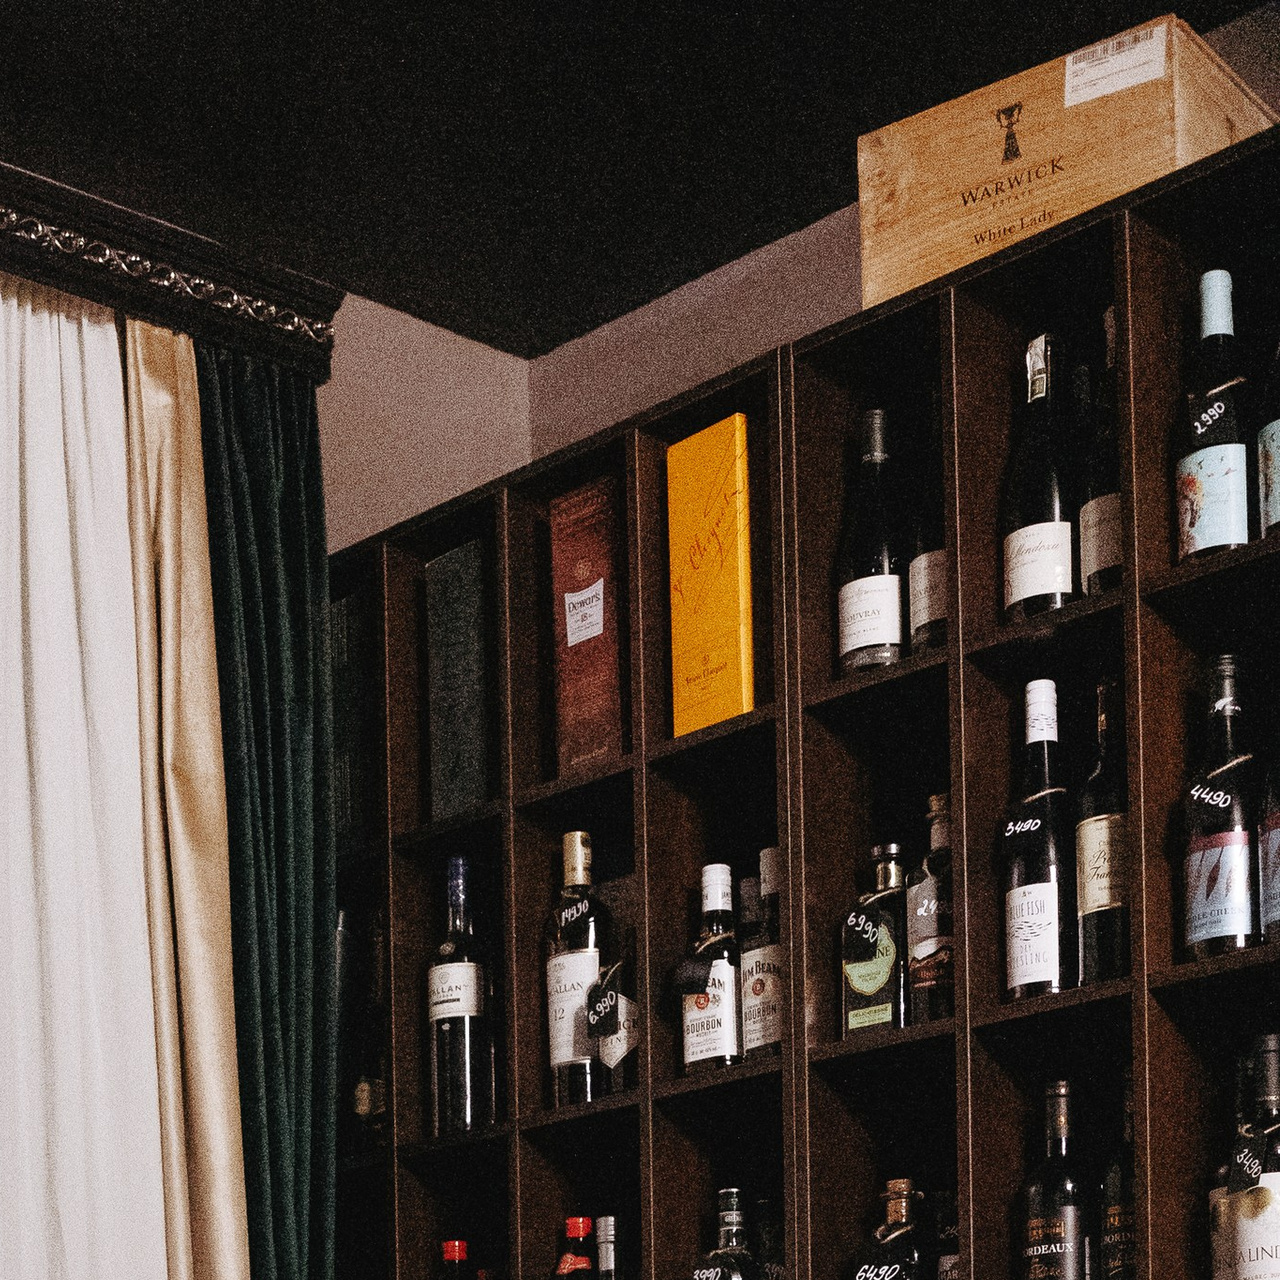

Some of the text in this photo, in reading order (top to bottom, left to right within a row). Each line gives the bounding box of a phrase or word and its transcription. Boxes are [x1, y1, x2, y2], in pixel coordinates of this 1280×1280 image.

[961, 155, 1064, 206] WARWICK
[974, 210, 1055, 245] White Lady
[1194, 401, 1225, 435] 2990
[1190, 784, 1231, 807] 4490
[1005, 819, 1041, 836] 3490
[1027, 900, 1045, 916] FISH
[847, 912, 878, 942] 6990
[686, 1018, 722, 1035] BOURBON
[1237, 1149, 1262, 1178] 3490
[1022, 1243, 1074, 1257] ORDEAUX
